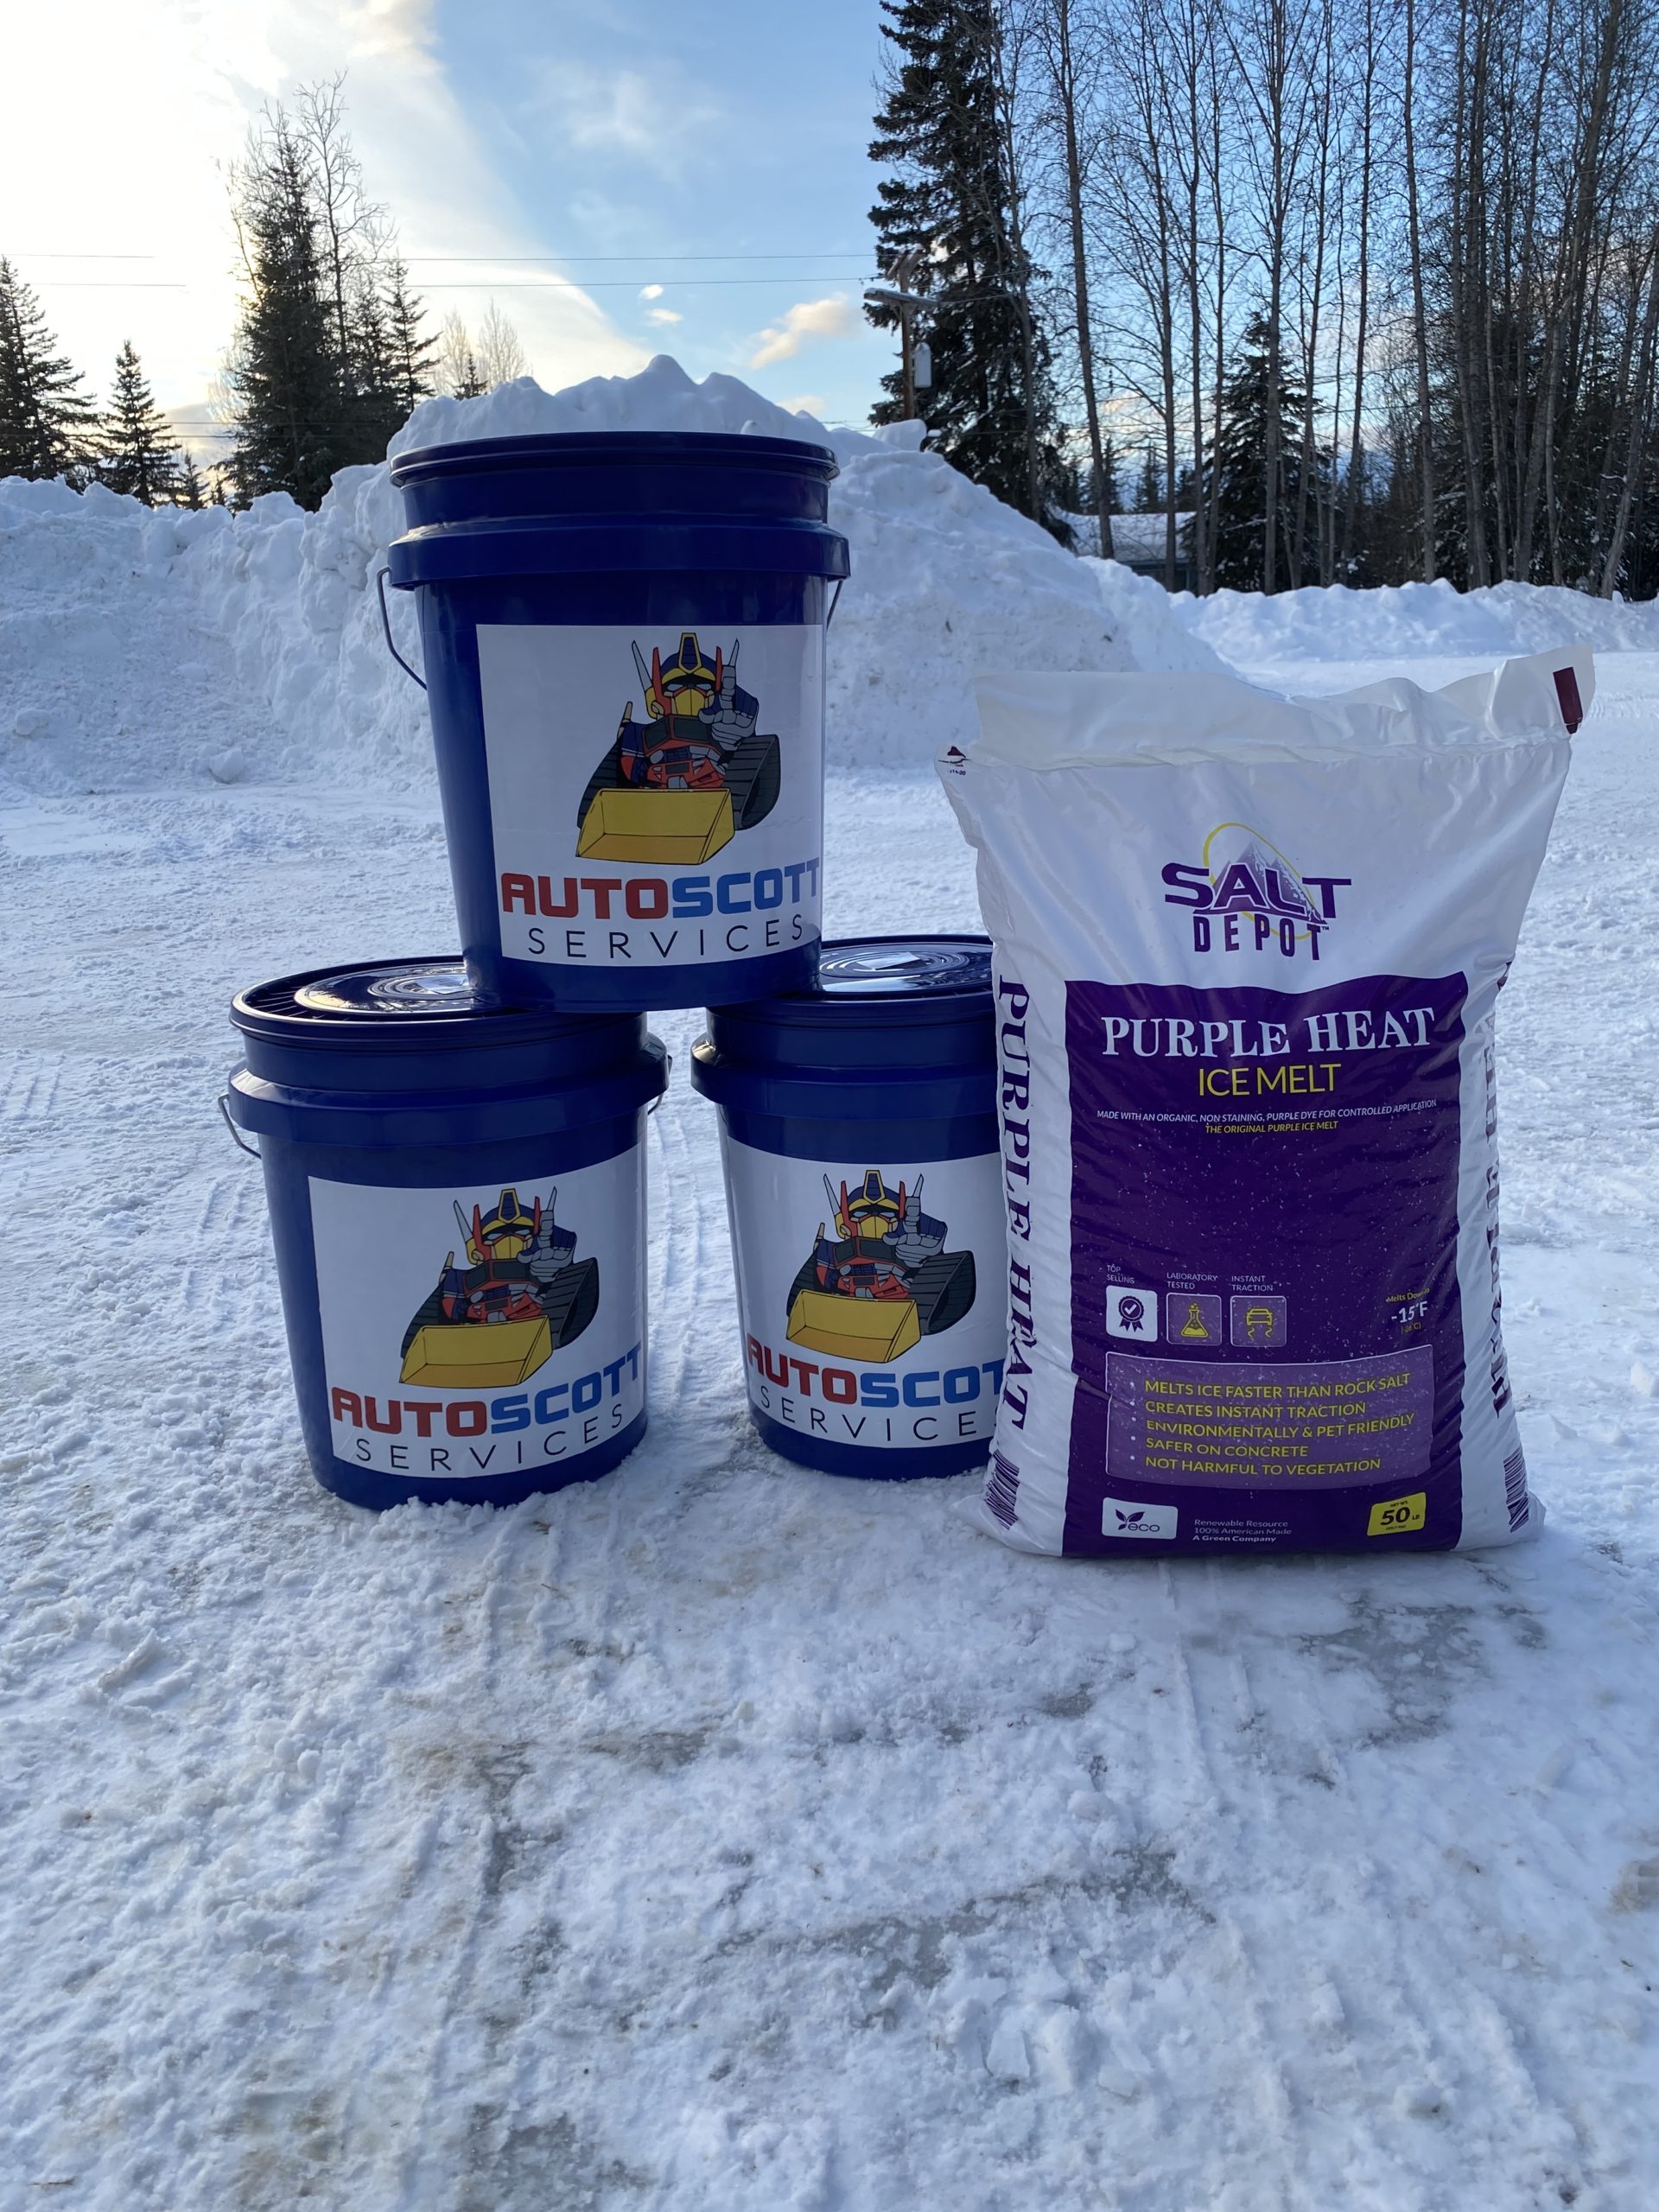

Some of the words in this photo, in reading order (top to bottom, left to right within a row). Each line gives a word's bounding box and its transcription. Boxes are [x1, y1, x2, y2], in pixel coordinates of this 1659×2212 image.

[500, 856, 820, 920] AUTOSCOTT
[1161, 862, 1352, 918] SALT
[528, 913, 802, 958] SERVICES
[1192, 913, 1321, 961] DEPOT
[1101, 1016, 1291, 1058] PURPLE
[1303, 1007, 1435, 1052] HEAT
[1198, 1067, 1249, 1096] ICE
[1256, 1063, 1342, 1095] MELT
[998, 974, 1032, 1242] PURPLE
[1096, 1110, 1119, 1120] MADE
[1121, 1111, 1141, 1121] WITH
[1142, 1113, 1155, 1122] AN
[1156, 1113, 1198, 1122] ORGANIC,
[1199, 1114, 1221, 1122] NON
[1221, 1113, 1265, 1122] STAINING,
[1267, 1111, 1299, 1122] PURPLE
[1300, 1110, 1318, 1119] DYE
[1319, 1109, 1336, 1118] FOR
[1338, 1105, 1392, 1117] CONTROLLED
[1393, 1099, 1437, 1113] APPLICATION
[1205, 1124, 1222, 1134] THE
[1224, 1124, 1266, 1134] ORIGINAL
[1268, 1122, 1300, 1133] PURPLE
[1301, 1122, 1315, 1131] ICE
[1316, 1121, 1338, 1130] MELT
[1106, 1265, 1121, 1274] TOP
[1106, 1274, 1135, 1284] SELLING
[1166, 1272, 1217, 1282] LABORATORY
[1167, 1281, 1195, 1290] TESTED
[1231, 1283, 1274, 1292] TRACTION
[1002, 1252, 1037, 1431] HEAT
[747, 1332, 1005, 1408] AUTOSCOT
[332, 1342, 642, 1438] AUTOSCOTT
[1145, 1380, 1193, 1395] MELTS
[1198, 1384, 1222, 1397] ICE
[1225, 1385, 1282, 1398] FASTER
[1286, 1385, 1331, 1398] THAN
[1335, 1380, 1376, 1396] ROCK
[1378, 1372, 1410, 1390] SALT
[760, 1385, 997, 1441] SERVICE
[1145, 1401, 1212, 1417] CREATES
[1217, 1405, 1284, 1418] INSTANT
[1287, 1402, 1366, 1419] TRACTION
[355, 1403, 623, 1471] SERVICES
[1147, 1420, 1299, 1439] ENVIRONMENTALLY
[1302, 1426, 1313, 1438] &
[1317, 1425, 1344, 1438] PET
[1347, 1413, 1415, 1435] FRIENDLY
[1146, 1437, 1193, 1453] SAFER
[1196, 1444, 1221, 1455] ON
[1224, 1446, 1309, 1458] CONCRETE
[1146, 1456, 1178, 1470] NOT
[1181, 1460, 1258, 1475] HARMFUL
[1262, 1464, 1283, 1475] TO
[1286, 1458, 1382, 1475] VEGETATION
[1193, 1518, 1244, 1528] Renewable
[1246, 1519, 1288, 1528] Resource
[1380, 1506, 1410, 1526] 50
[1128, 1523, 1160, 1533] eco
[1221, 1527, 1268, 1535] American
[1231, 1535, 1276, 1543] Company
